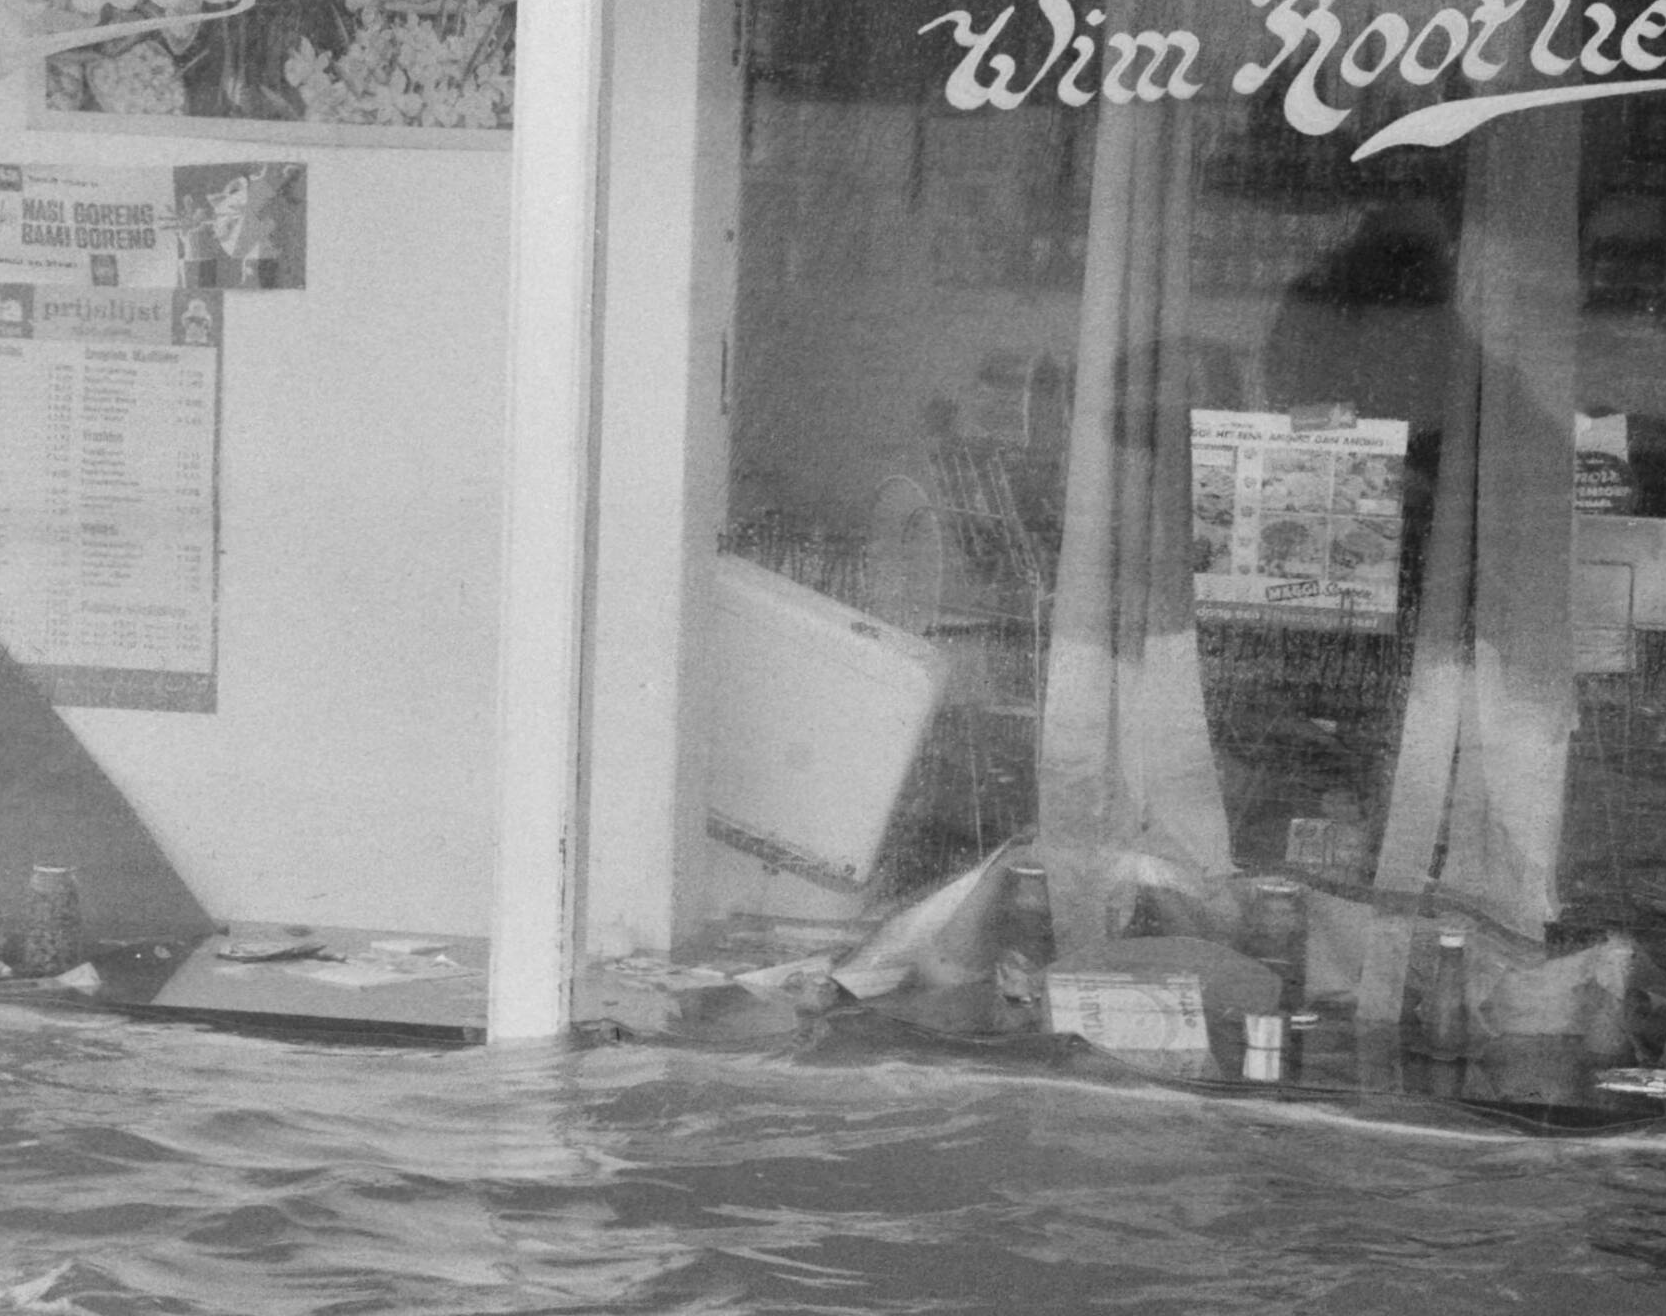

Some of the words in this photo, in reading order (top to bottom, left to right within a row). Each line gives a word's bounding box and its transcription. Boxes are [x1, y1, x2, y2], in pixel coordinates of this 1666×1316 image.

[22, 198, 65, 224] NASI
[73, 202, 154, 227] GORENG
[22, 223, 71, 248] BAMI
[74, 227, 157, 250] GORENG
[43, 298, 162, 325] prijslijst
